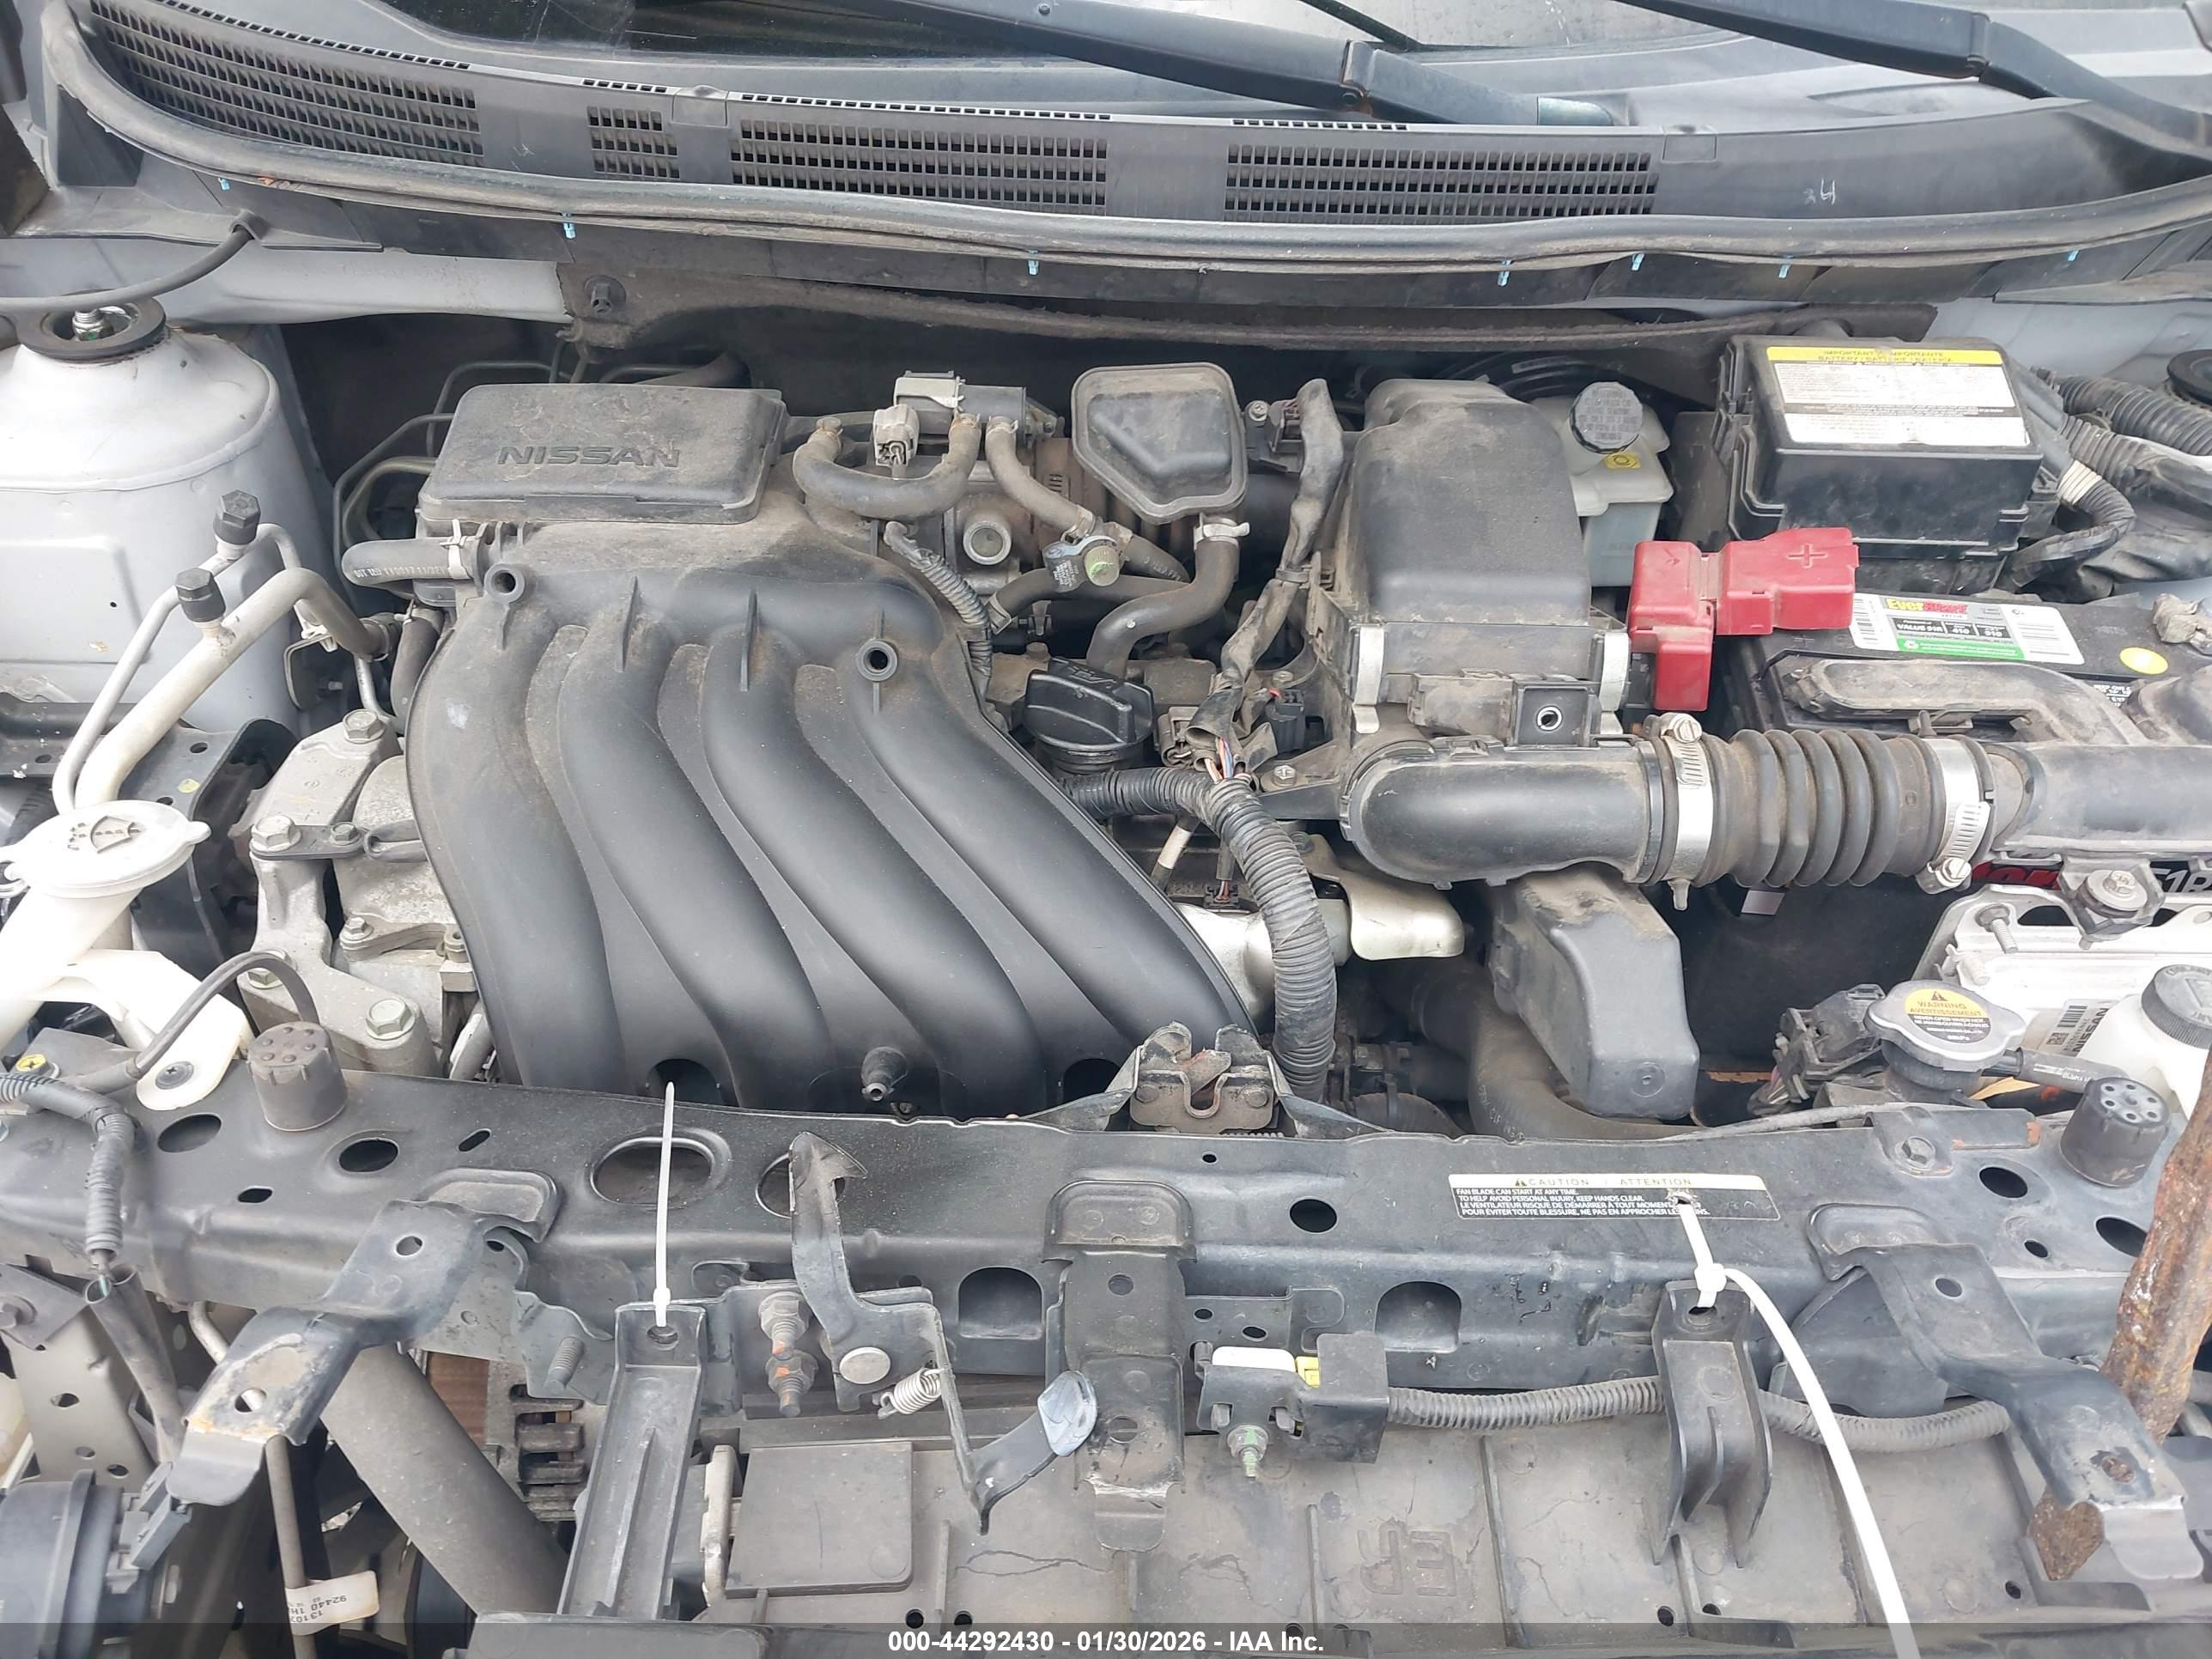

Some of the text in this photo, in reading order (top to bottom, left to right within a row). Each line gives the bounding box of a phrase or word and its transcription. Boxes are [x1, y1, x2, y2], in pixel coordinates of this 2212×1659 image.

[496, 446, 680, 468] NISSAN
[1897, 623, 1926, 632] VALUE
[1917, 1001, 1966, 1010] WARNING
[1910, 1007, 1982, 1016] AVERTISSEMENT
[2071, 1007, 2110, 1053] NISSAN
[1486, 1207, 1511, 1216] ÉVITER
[311, 1595, 347, 1611] 92440
